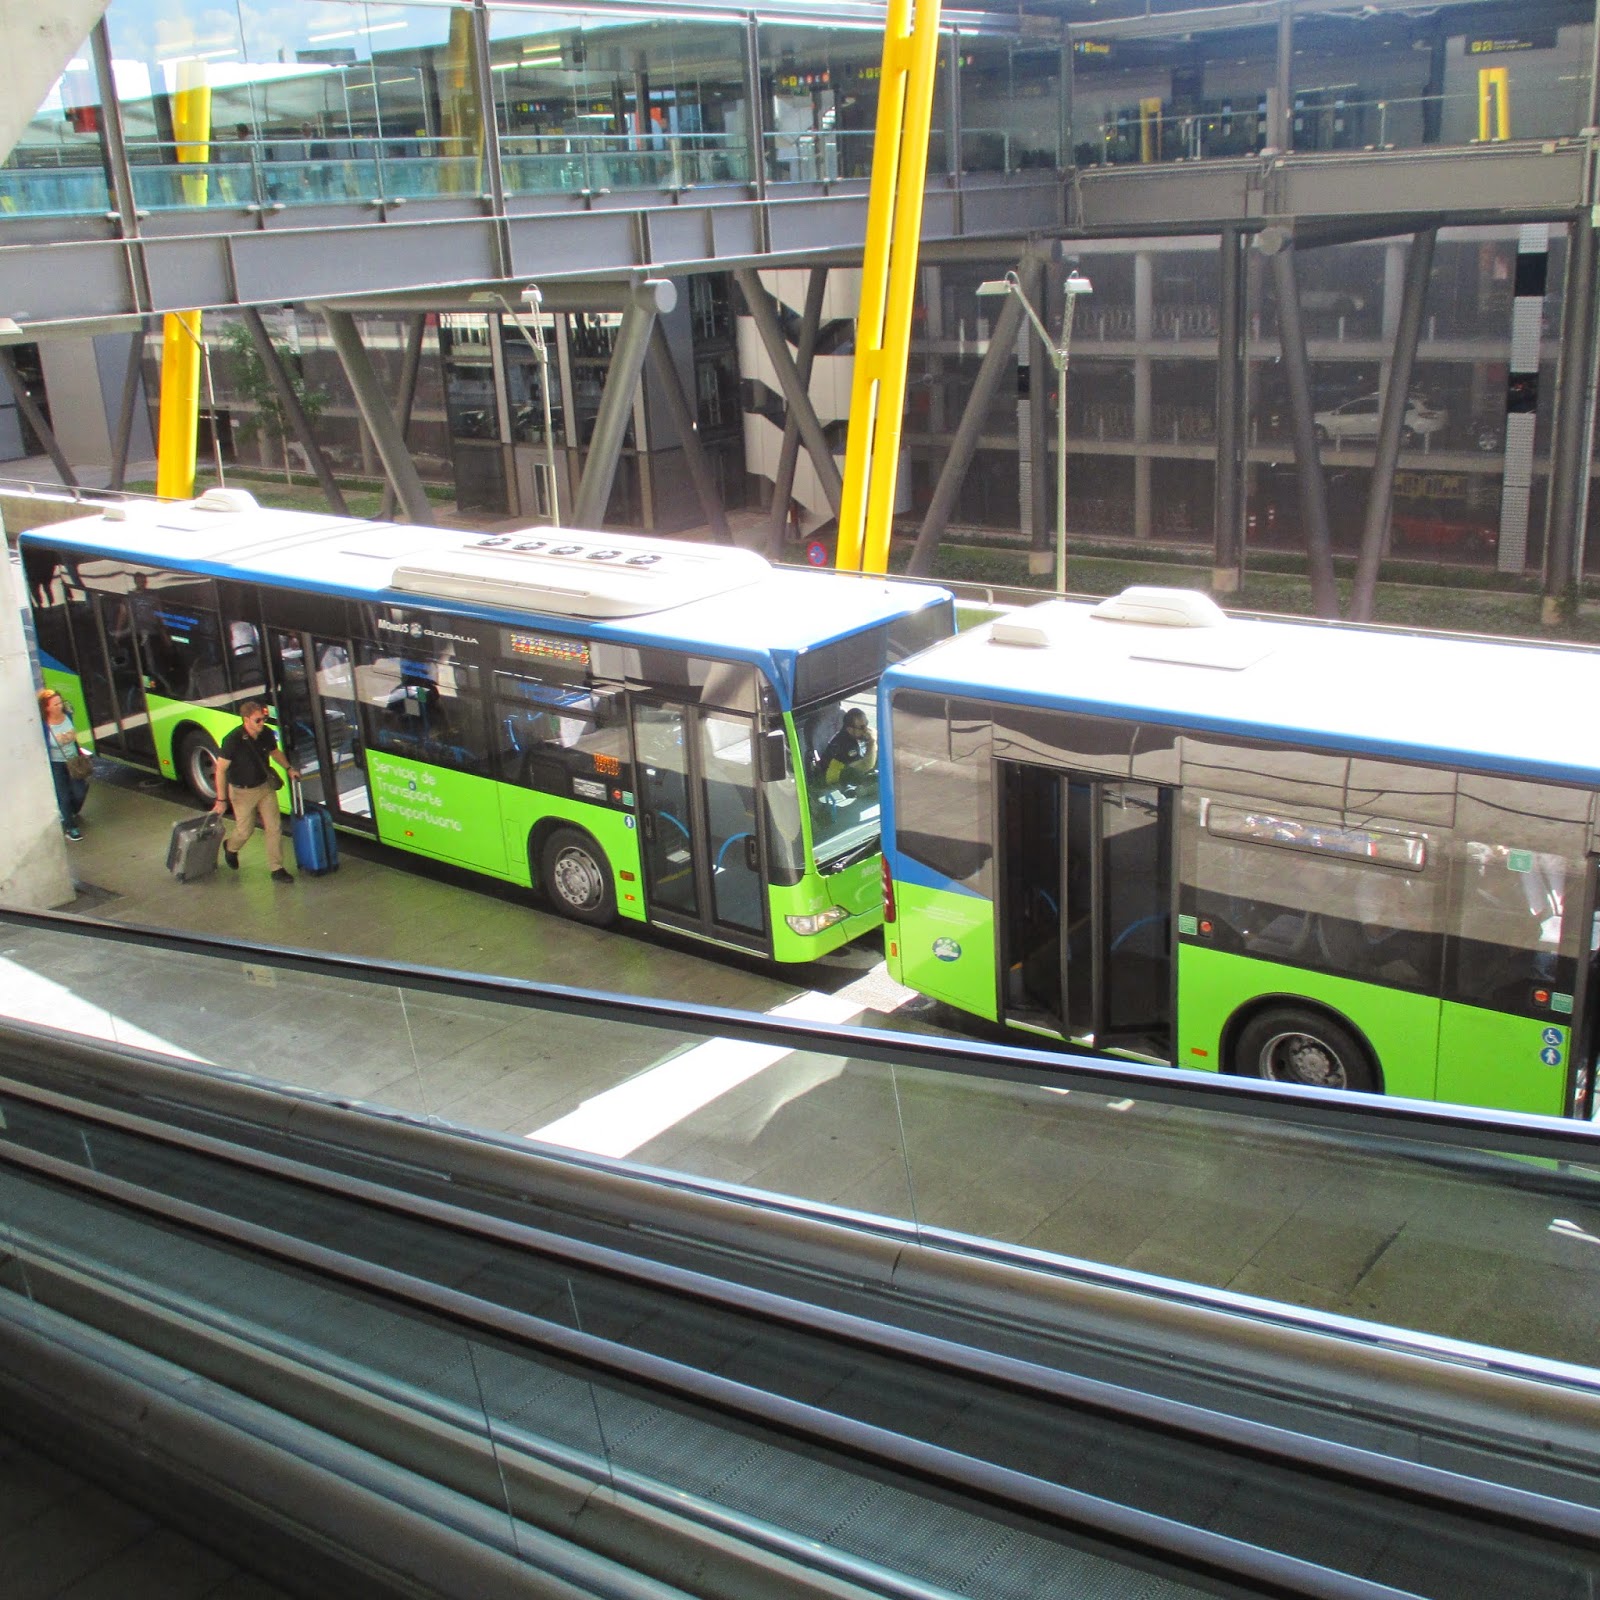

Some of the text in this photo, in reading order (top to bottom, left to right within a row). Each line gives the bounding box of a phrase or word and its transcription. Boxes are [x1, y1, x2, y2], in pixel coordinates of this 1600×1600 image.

[423, 629, 479, 644] GLOBALIA
[372, 757, 437, 786] Servicio de
[376, 776, 443, 807] Transporte
[379, 796, 463, 832] Aeroportuario
